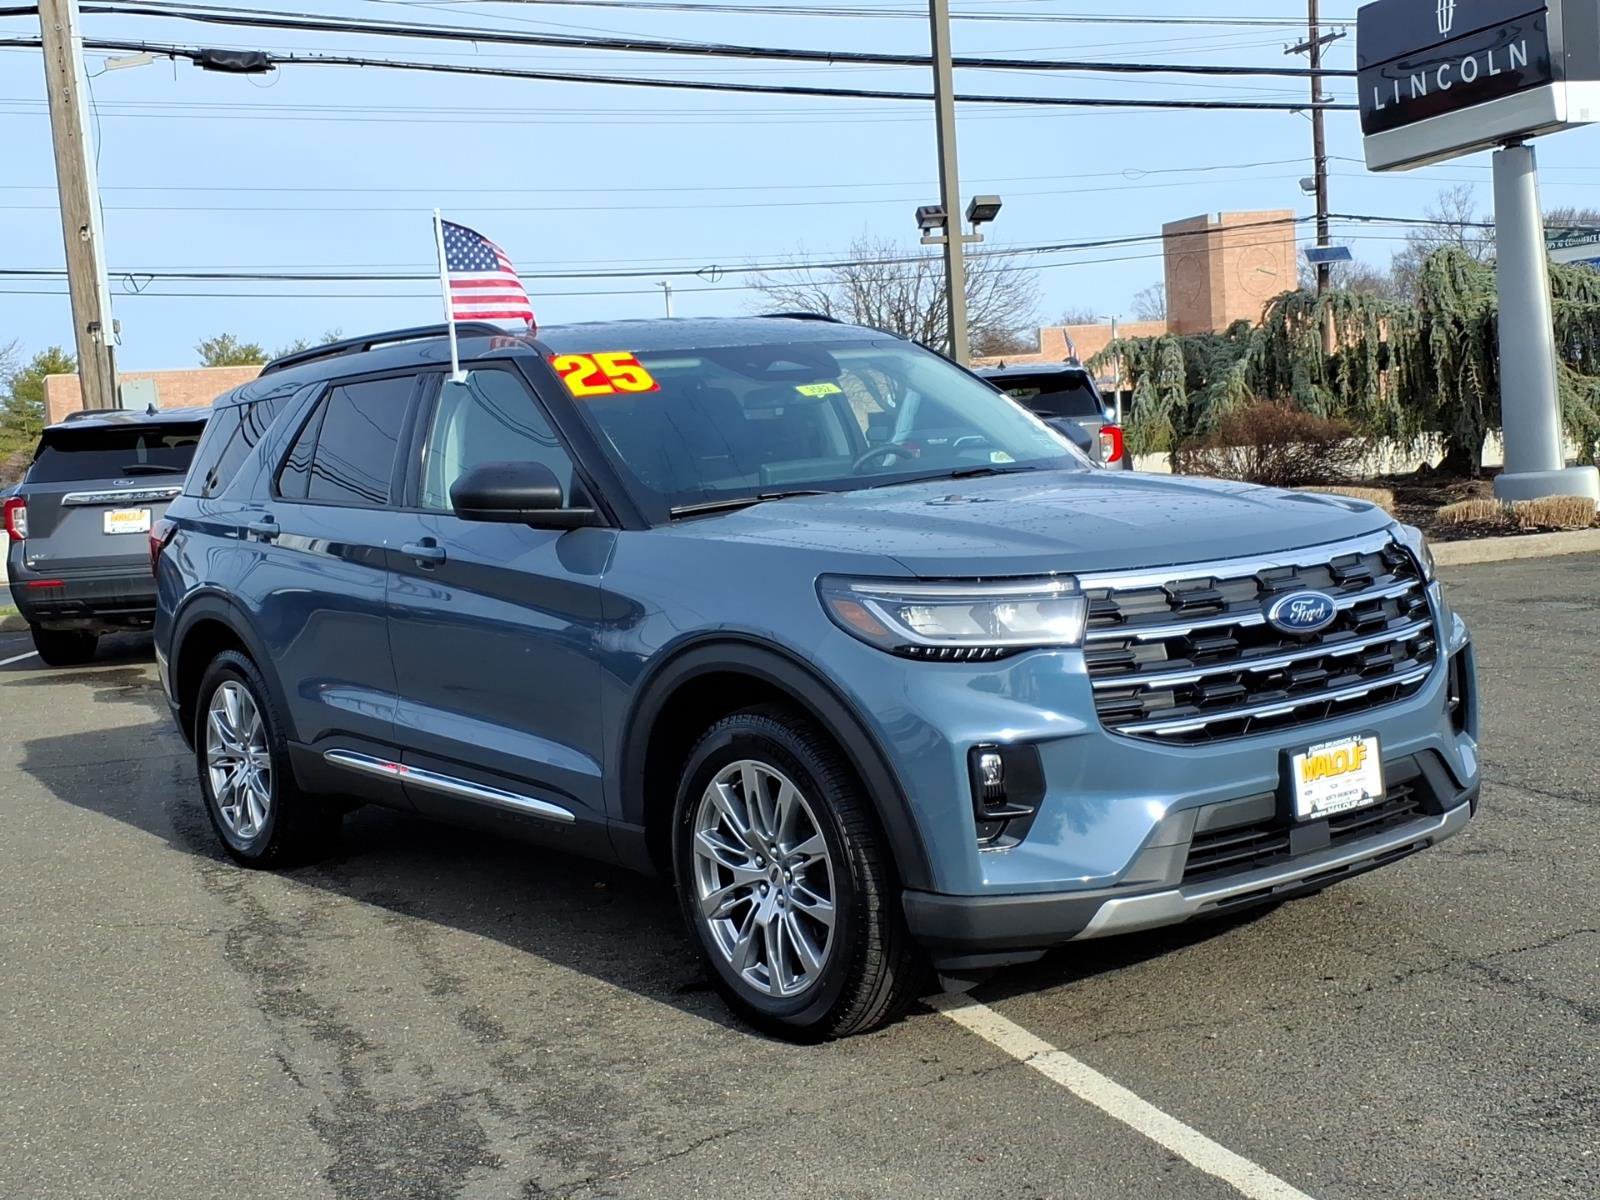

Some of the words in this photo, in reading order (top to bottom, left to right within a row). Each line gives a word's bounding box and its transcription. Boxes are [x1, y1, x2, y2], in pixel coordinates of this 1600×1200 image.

[1373, 40, 1528, 110] LINCOLN
[552, 351, 655, 398] 25
[1289, 599, 1326, 624] Ford
[1302, 744, 1367, 784] MALOUF
